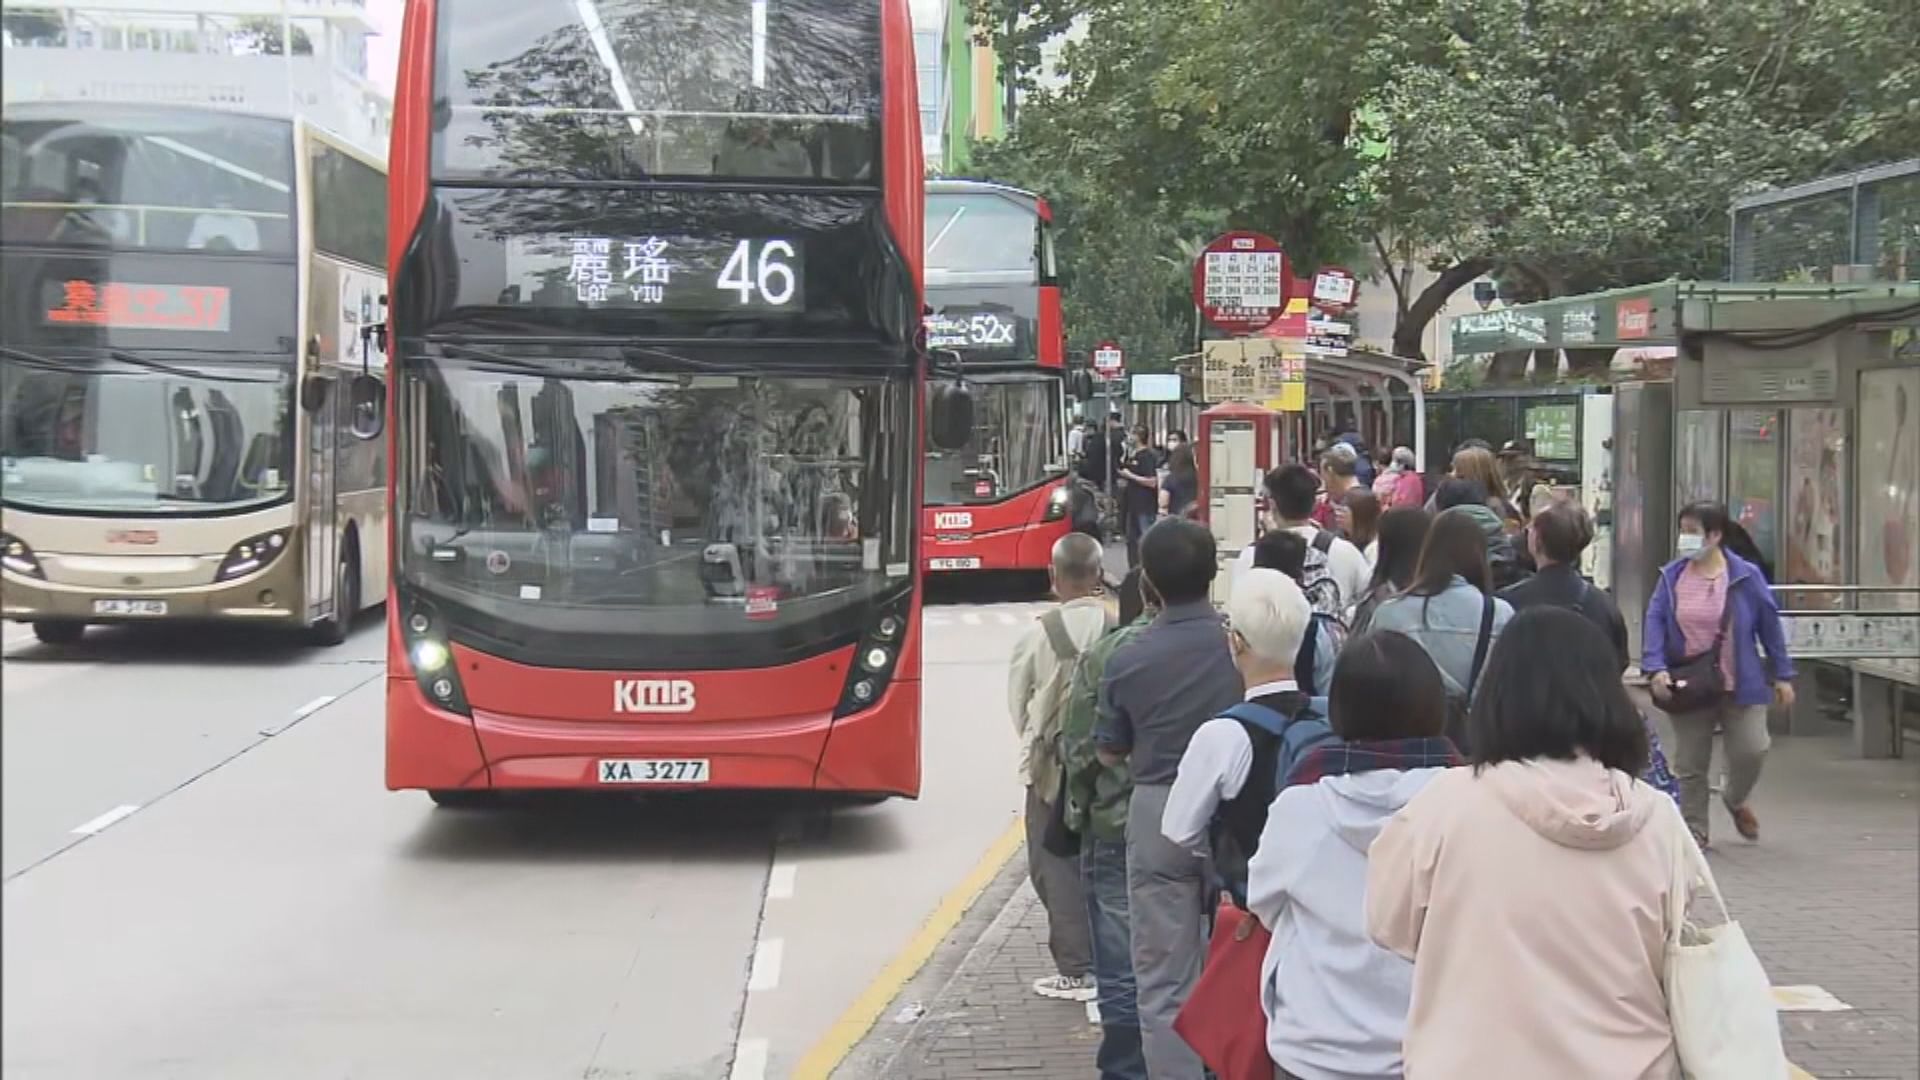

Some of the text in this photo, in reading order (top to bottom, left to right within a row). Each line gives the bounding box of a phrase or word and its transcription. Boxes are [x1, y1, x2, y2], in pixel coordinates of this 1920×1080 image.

[566, 235, 669, 284] 麗瑤
[717, 239, 796, 305] 46
[577, 284, 663, 304] LAI YIU
[614, 680, 695, 712] KMB
[604, 762, 702, 779] XA 3277
